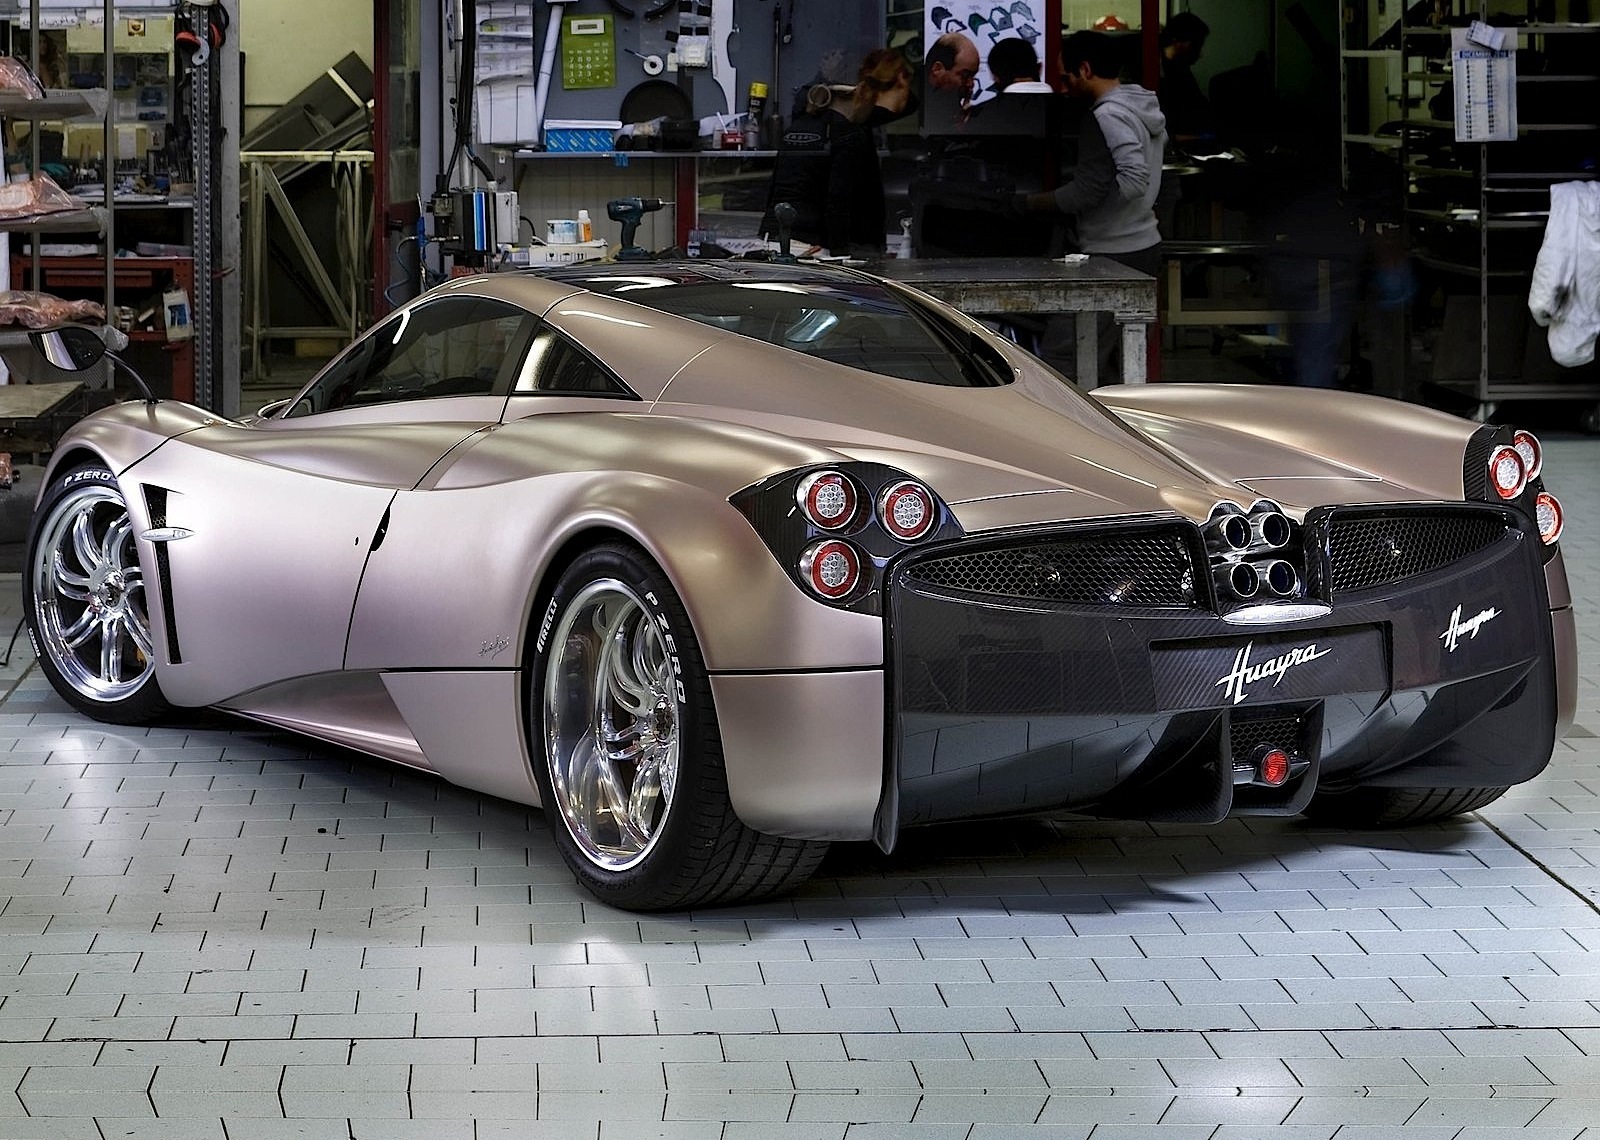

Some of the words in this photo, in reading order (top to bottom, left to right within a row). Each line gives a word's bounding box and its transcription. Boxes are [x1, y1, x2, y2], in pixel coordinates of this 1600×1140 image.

[64, 475, 73, 487] P
[74, 470, 111, 482] ZERO
[537, 596, 558, 653] PIRELLI
[645, 591, 659, 606] P
[656, 612, 686, 704] ZERO
[1439, 603, 1503, 653] Huayra
[1215, 640, 1333, 705] Huayra
